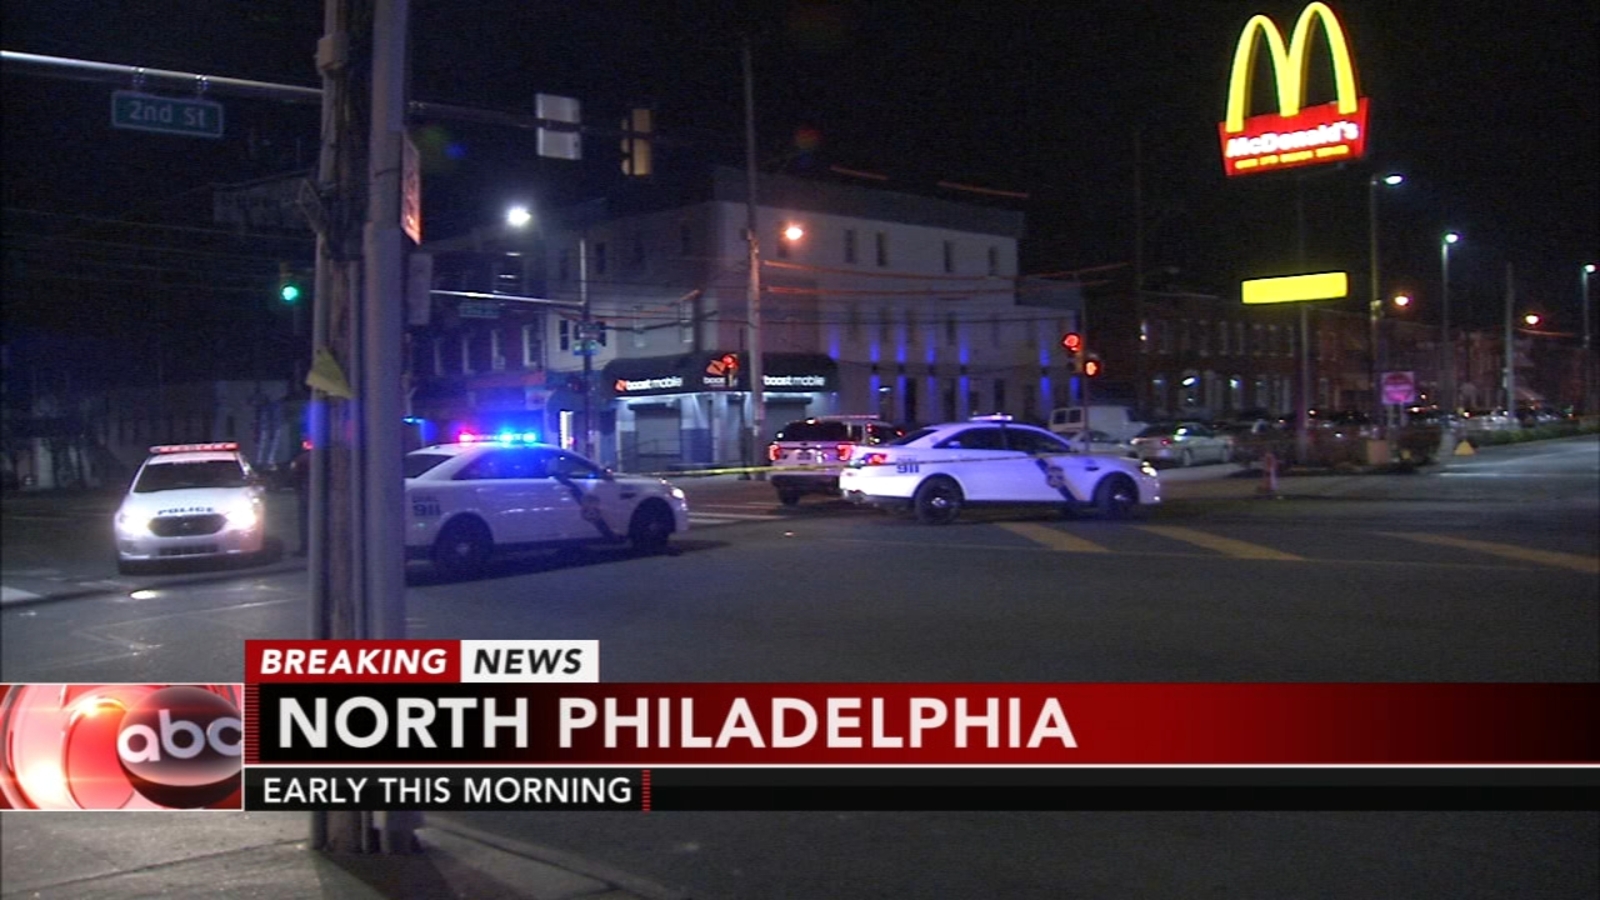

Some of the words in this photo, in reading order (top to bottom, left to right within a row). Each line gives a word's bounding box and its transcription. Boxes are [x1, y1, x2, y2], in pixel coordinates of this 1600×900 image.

[129, 100, 173, 122] 2nd
[184, 106, 206, 127] St
[1225, 121, 1360, 158] McDonald's
[896, 463, 920, 473] 911
[157, 506, 214, 516] POLICE
[413, 503, 441, 516] 911
